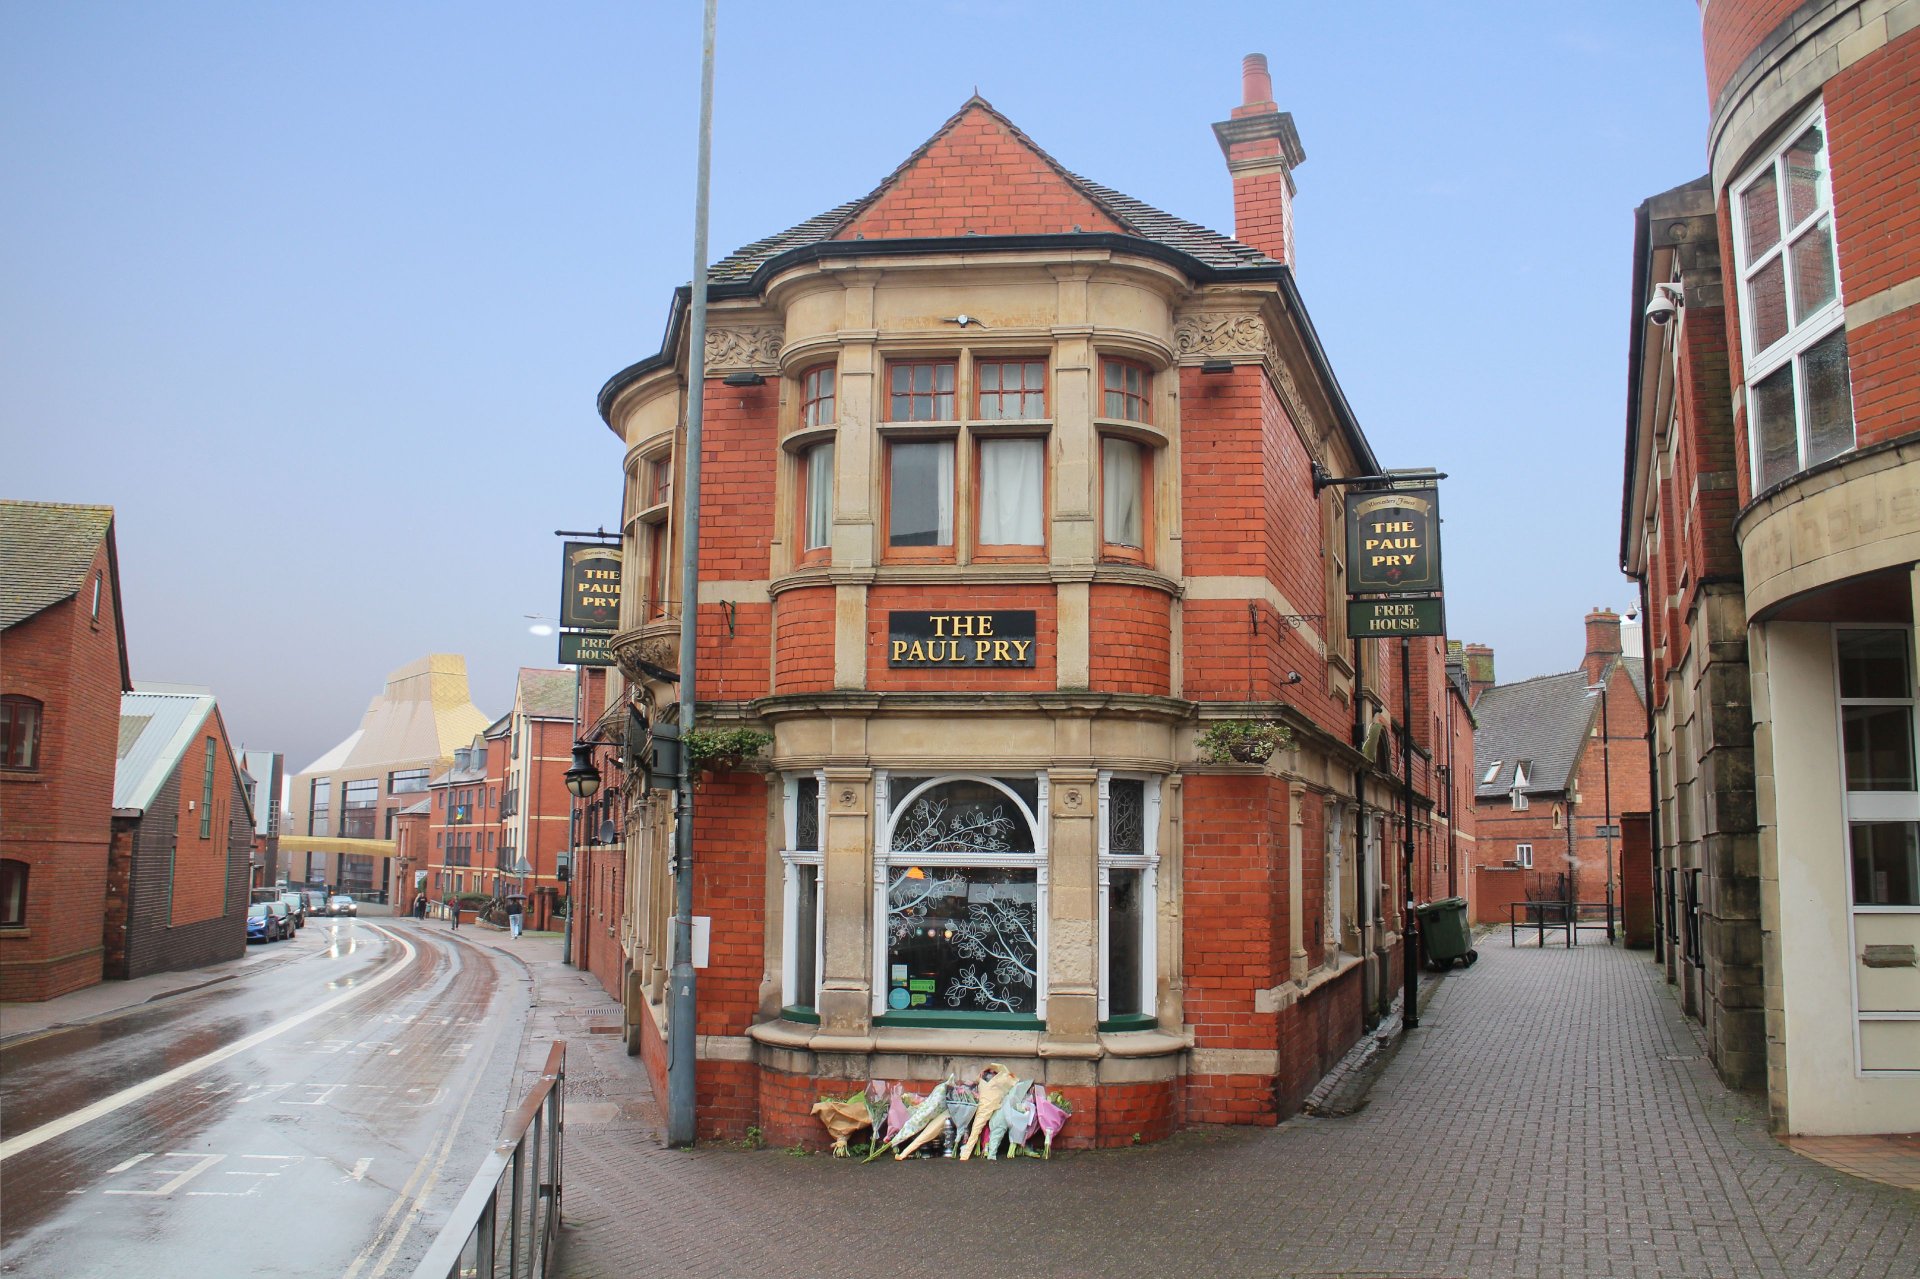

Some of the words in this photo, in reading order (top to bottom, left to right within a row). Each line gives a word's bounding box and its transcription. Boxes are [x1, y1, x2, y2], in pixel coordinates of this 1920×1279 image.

[1371, 522, 1415, 533] THE
[1365, 538, 1422, 550] PAUL
[1372, 555, 1415, 566] PRY
[585, 570, 620, 579] THE
[583, 597, 619, 607] PRY
[1374, 604, 1415, 617] FREE
[930, 616, 993, 636] THE
[1369, 618, 1420, 631] HOUSE
[892, 641, 965, 661] PAUL
[975, 641, 1031, 661] PRY
